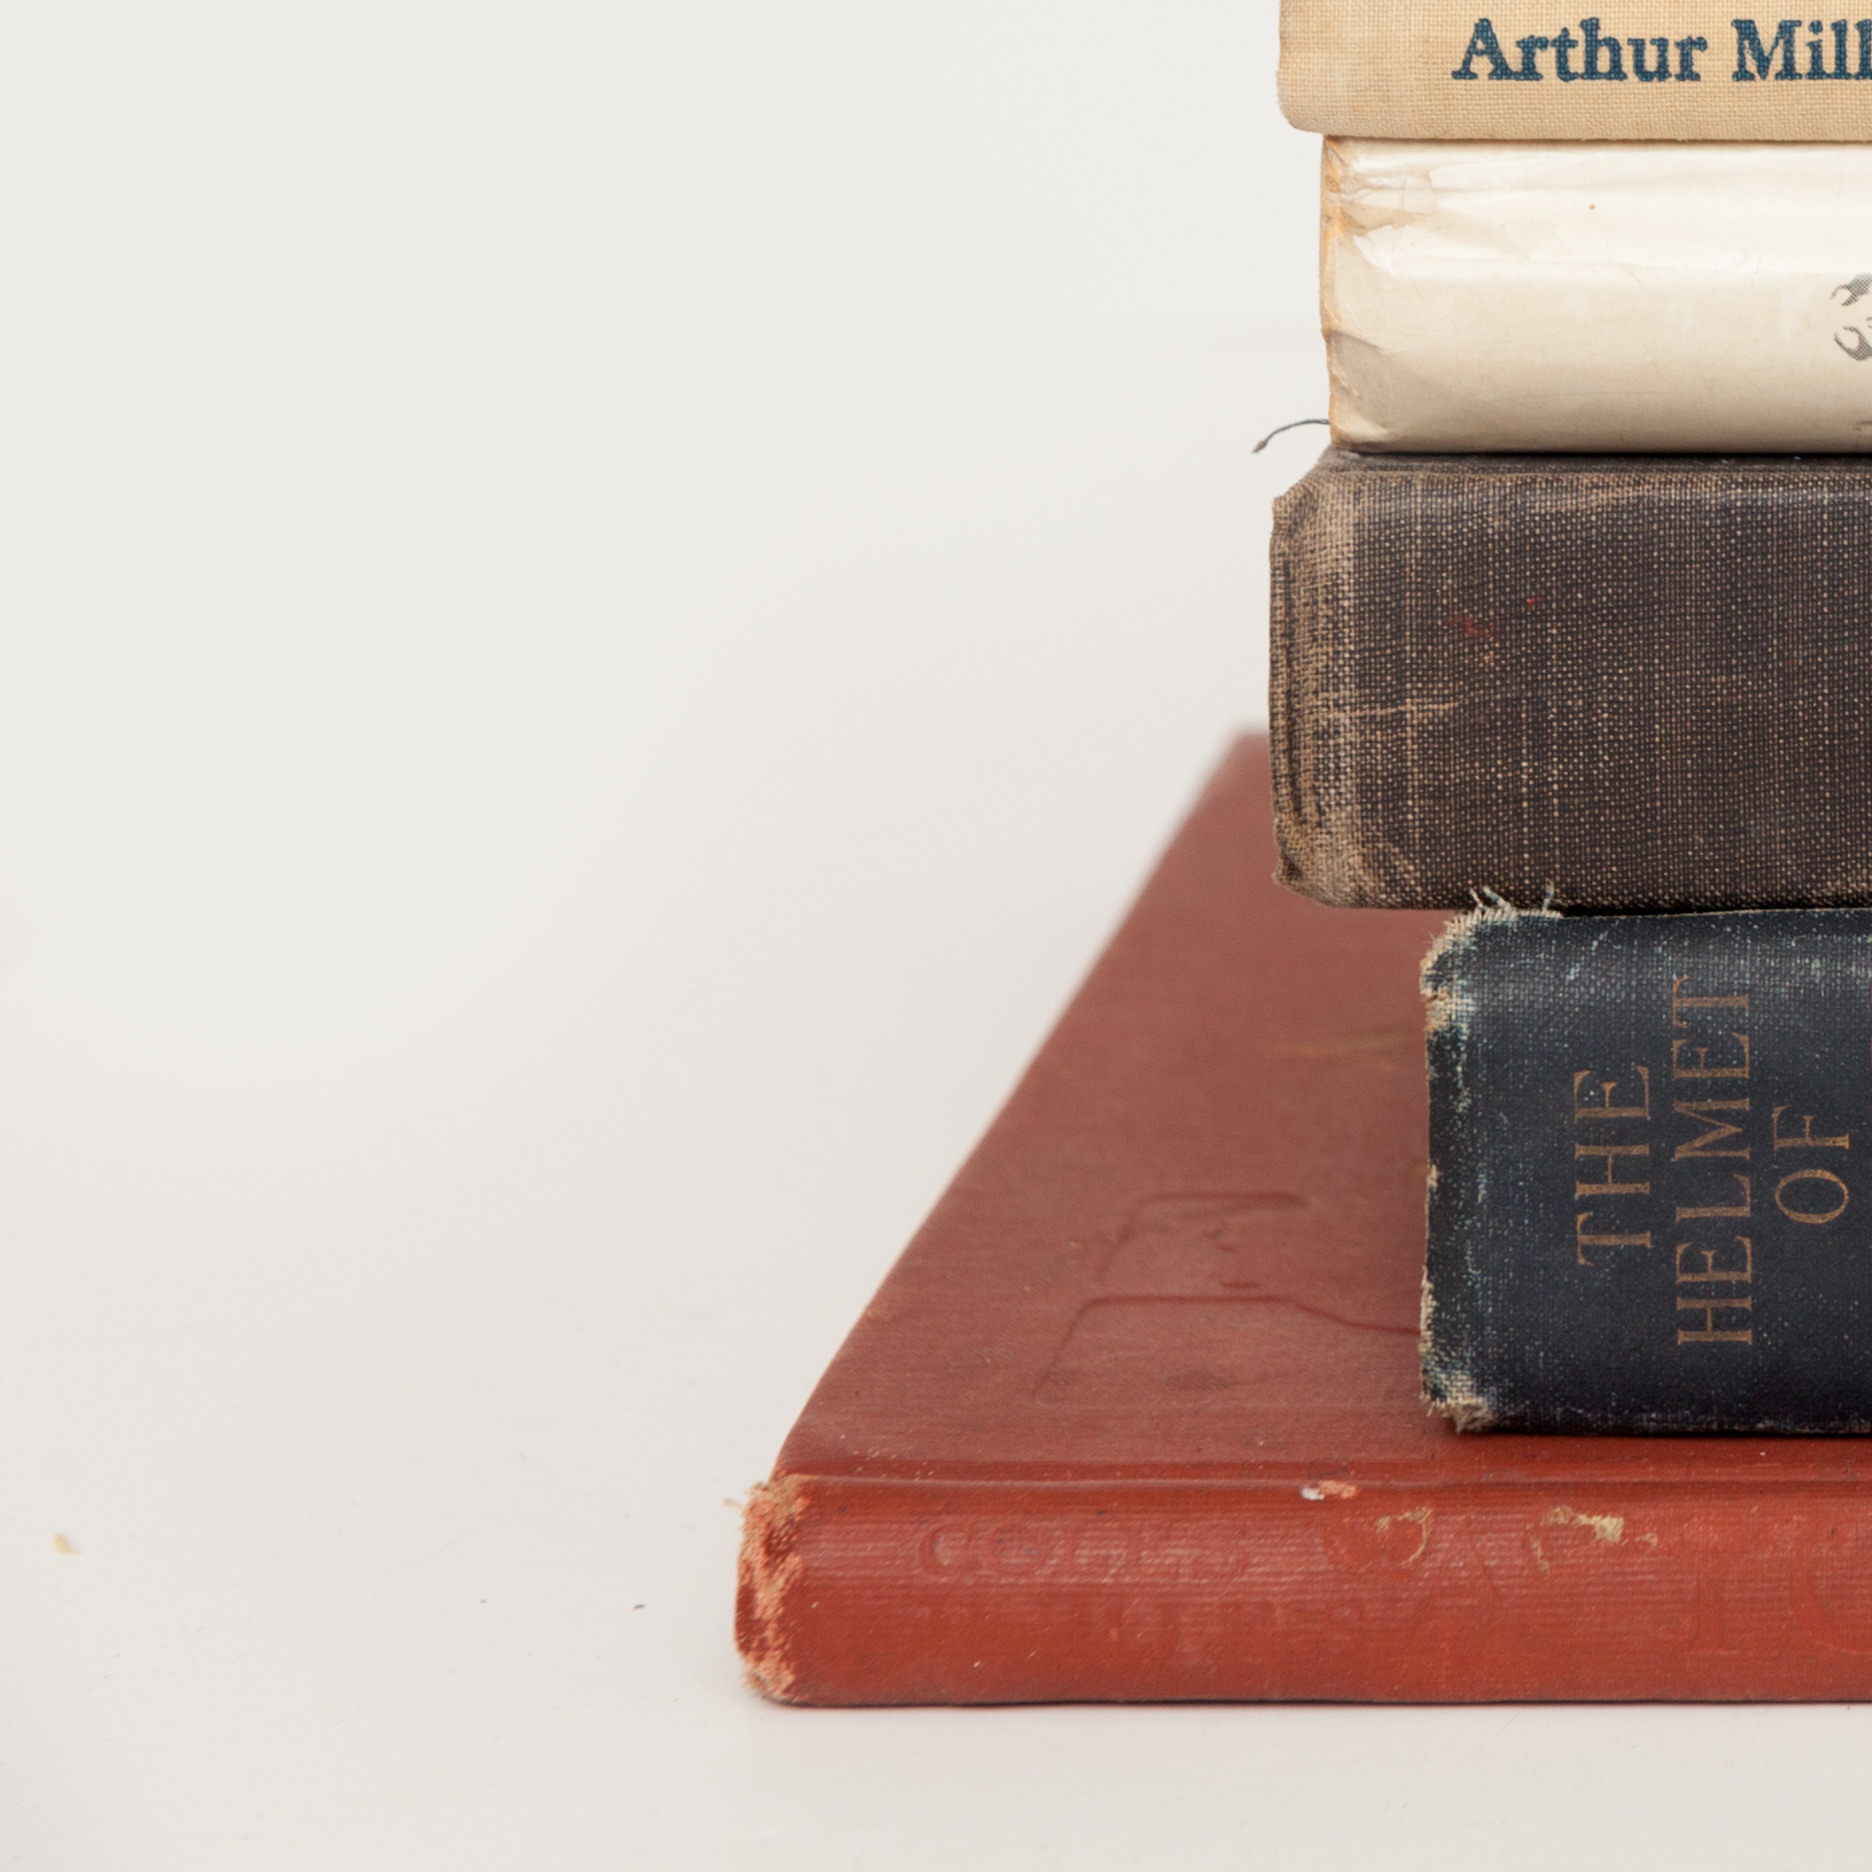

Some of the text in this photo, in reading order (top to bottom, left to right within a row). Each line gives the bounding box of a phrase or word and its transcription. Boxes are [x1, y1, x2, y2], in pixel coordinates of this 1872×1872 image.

[1450, 16, 1707, 84] Arthur
[1573, 1064, 1652, 1267] THE
[1671, 974, 1753, 1346] HELMET
[1773, 1105, 1851, 1225] OF
